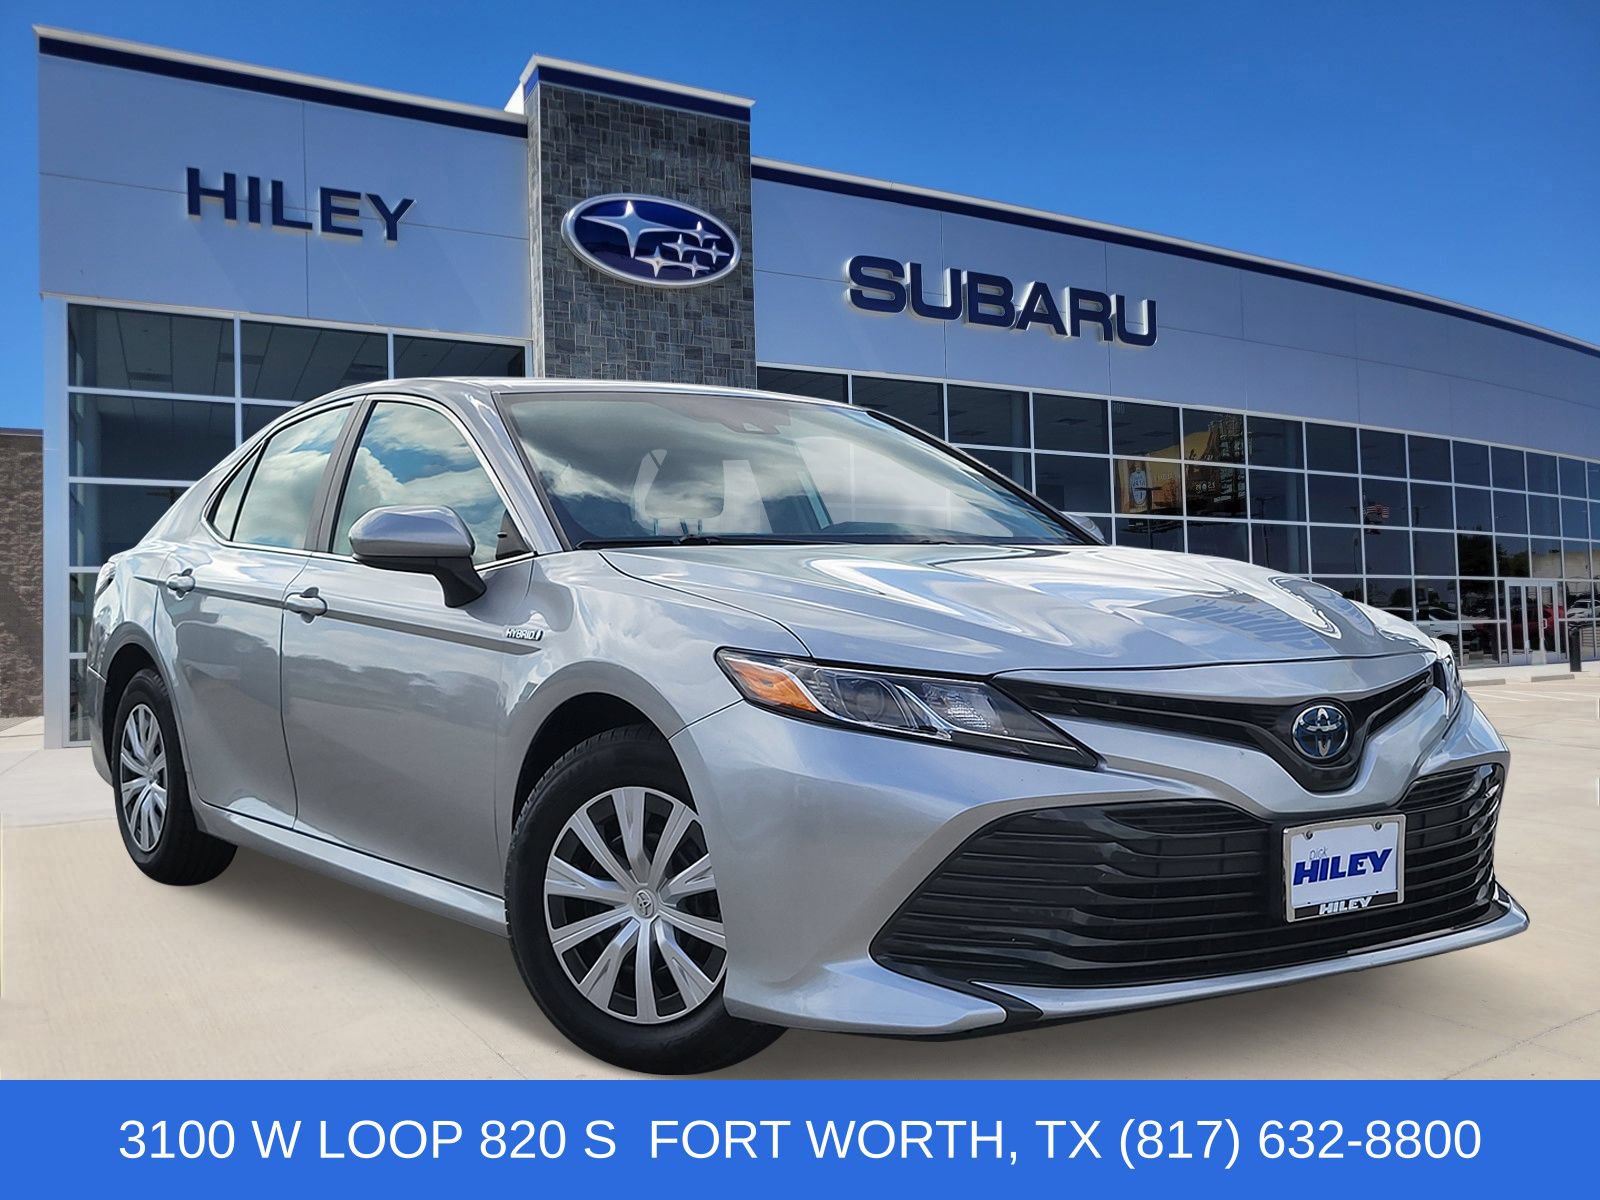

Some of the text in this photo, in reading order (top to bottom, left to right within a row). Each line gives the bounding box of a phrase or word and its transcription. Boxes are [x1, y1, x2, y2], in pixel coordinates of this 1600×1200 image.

[186, 167, 416, 242] HILEY
[847, 255, 1158, 347] SUBARU
[506, 628, 535, 640] HYBRID
[1293, 848, 1393, 885] HILEY
[1319, 896, 1372, 915] HILEY
